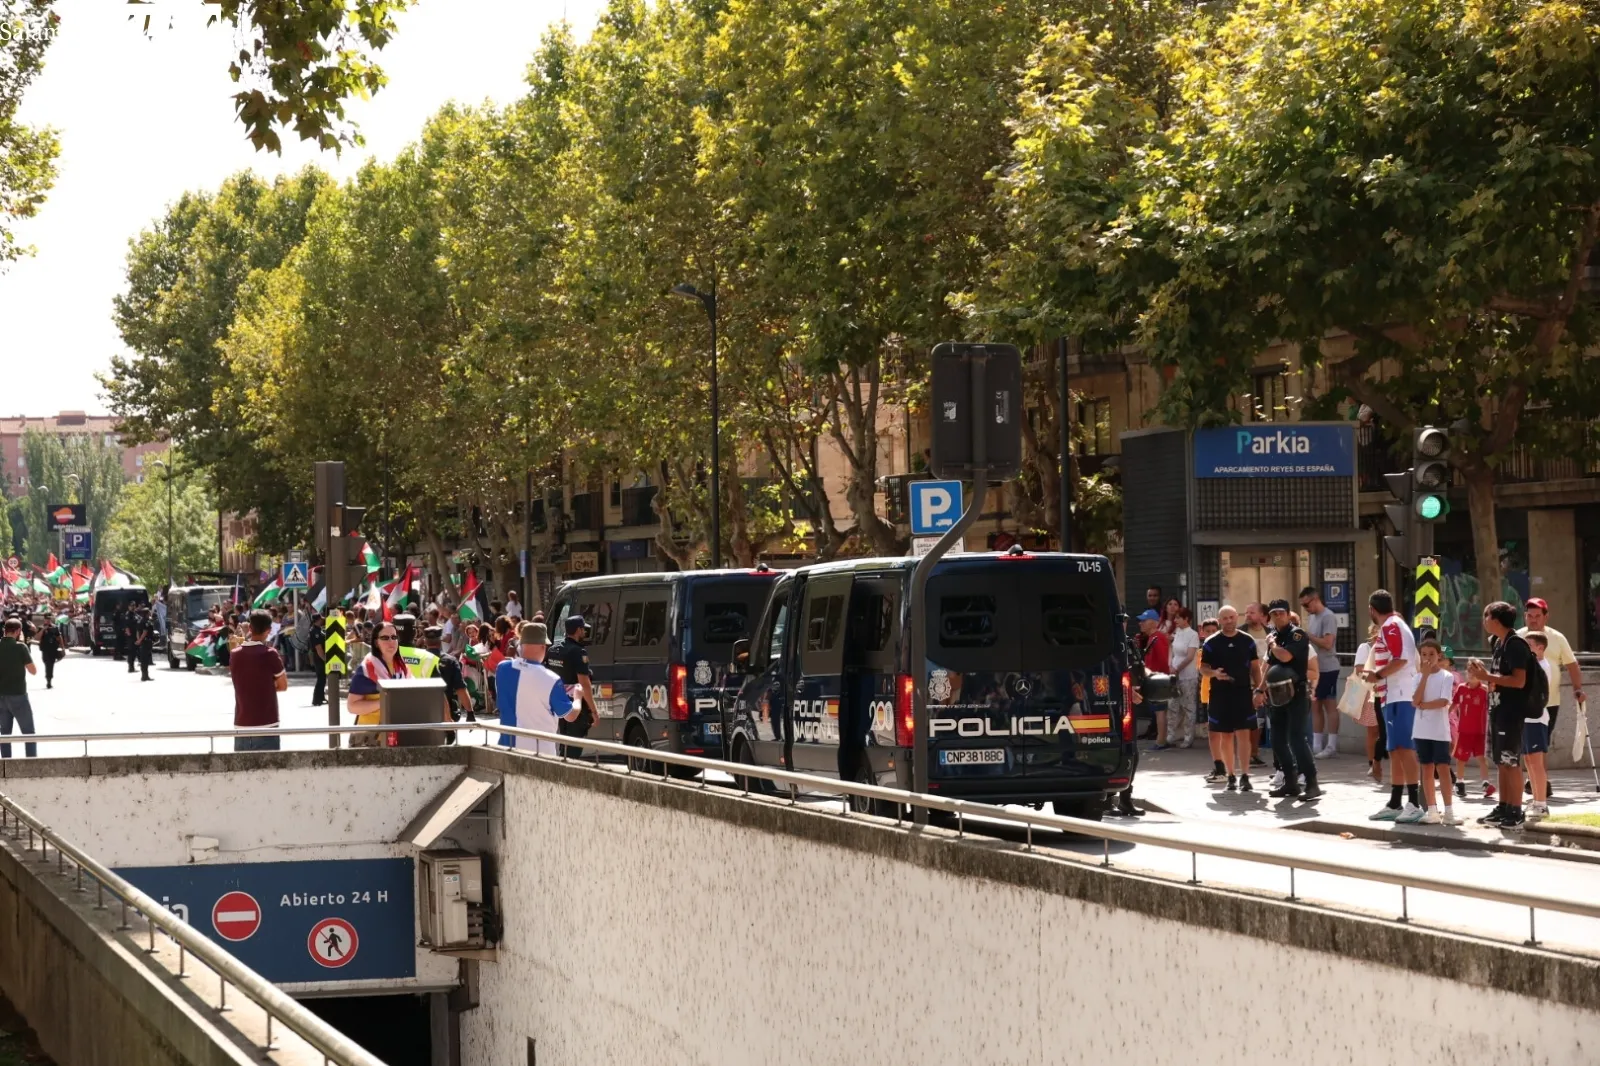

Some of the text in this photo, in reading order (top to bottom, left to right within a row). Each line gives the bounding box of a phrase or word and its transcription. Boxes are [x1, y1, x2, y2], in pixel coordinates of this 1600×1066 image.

[1237, 430, 1310, 454] Parkia
[1214, 465, 1269, 473] APARCAMIENTO
[1307, 463, 1335, 472] ESPAÑA
[921, 488, 952, 528] P
[73, 534, 83, 547] P
[1077, 561, 1101, 573] 7U-15
[645, 685, 668, 709] 200
[869, 700, 894, 732] 200
[946, 751, 1004, 763] CNP3818BC
[280, 890, 388, 907] Abierto 24 H
